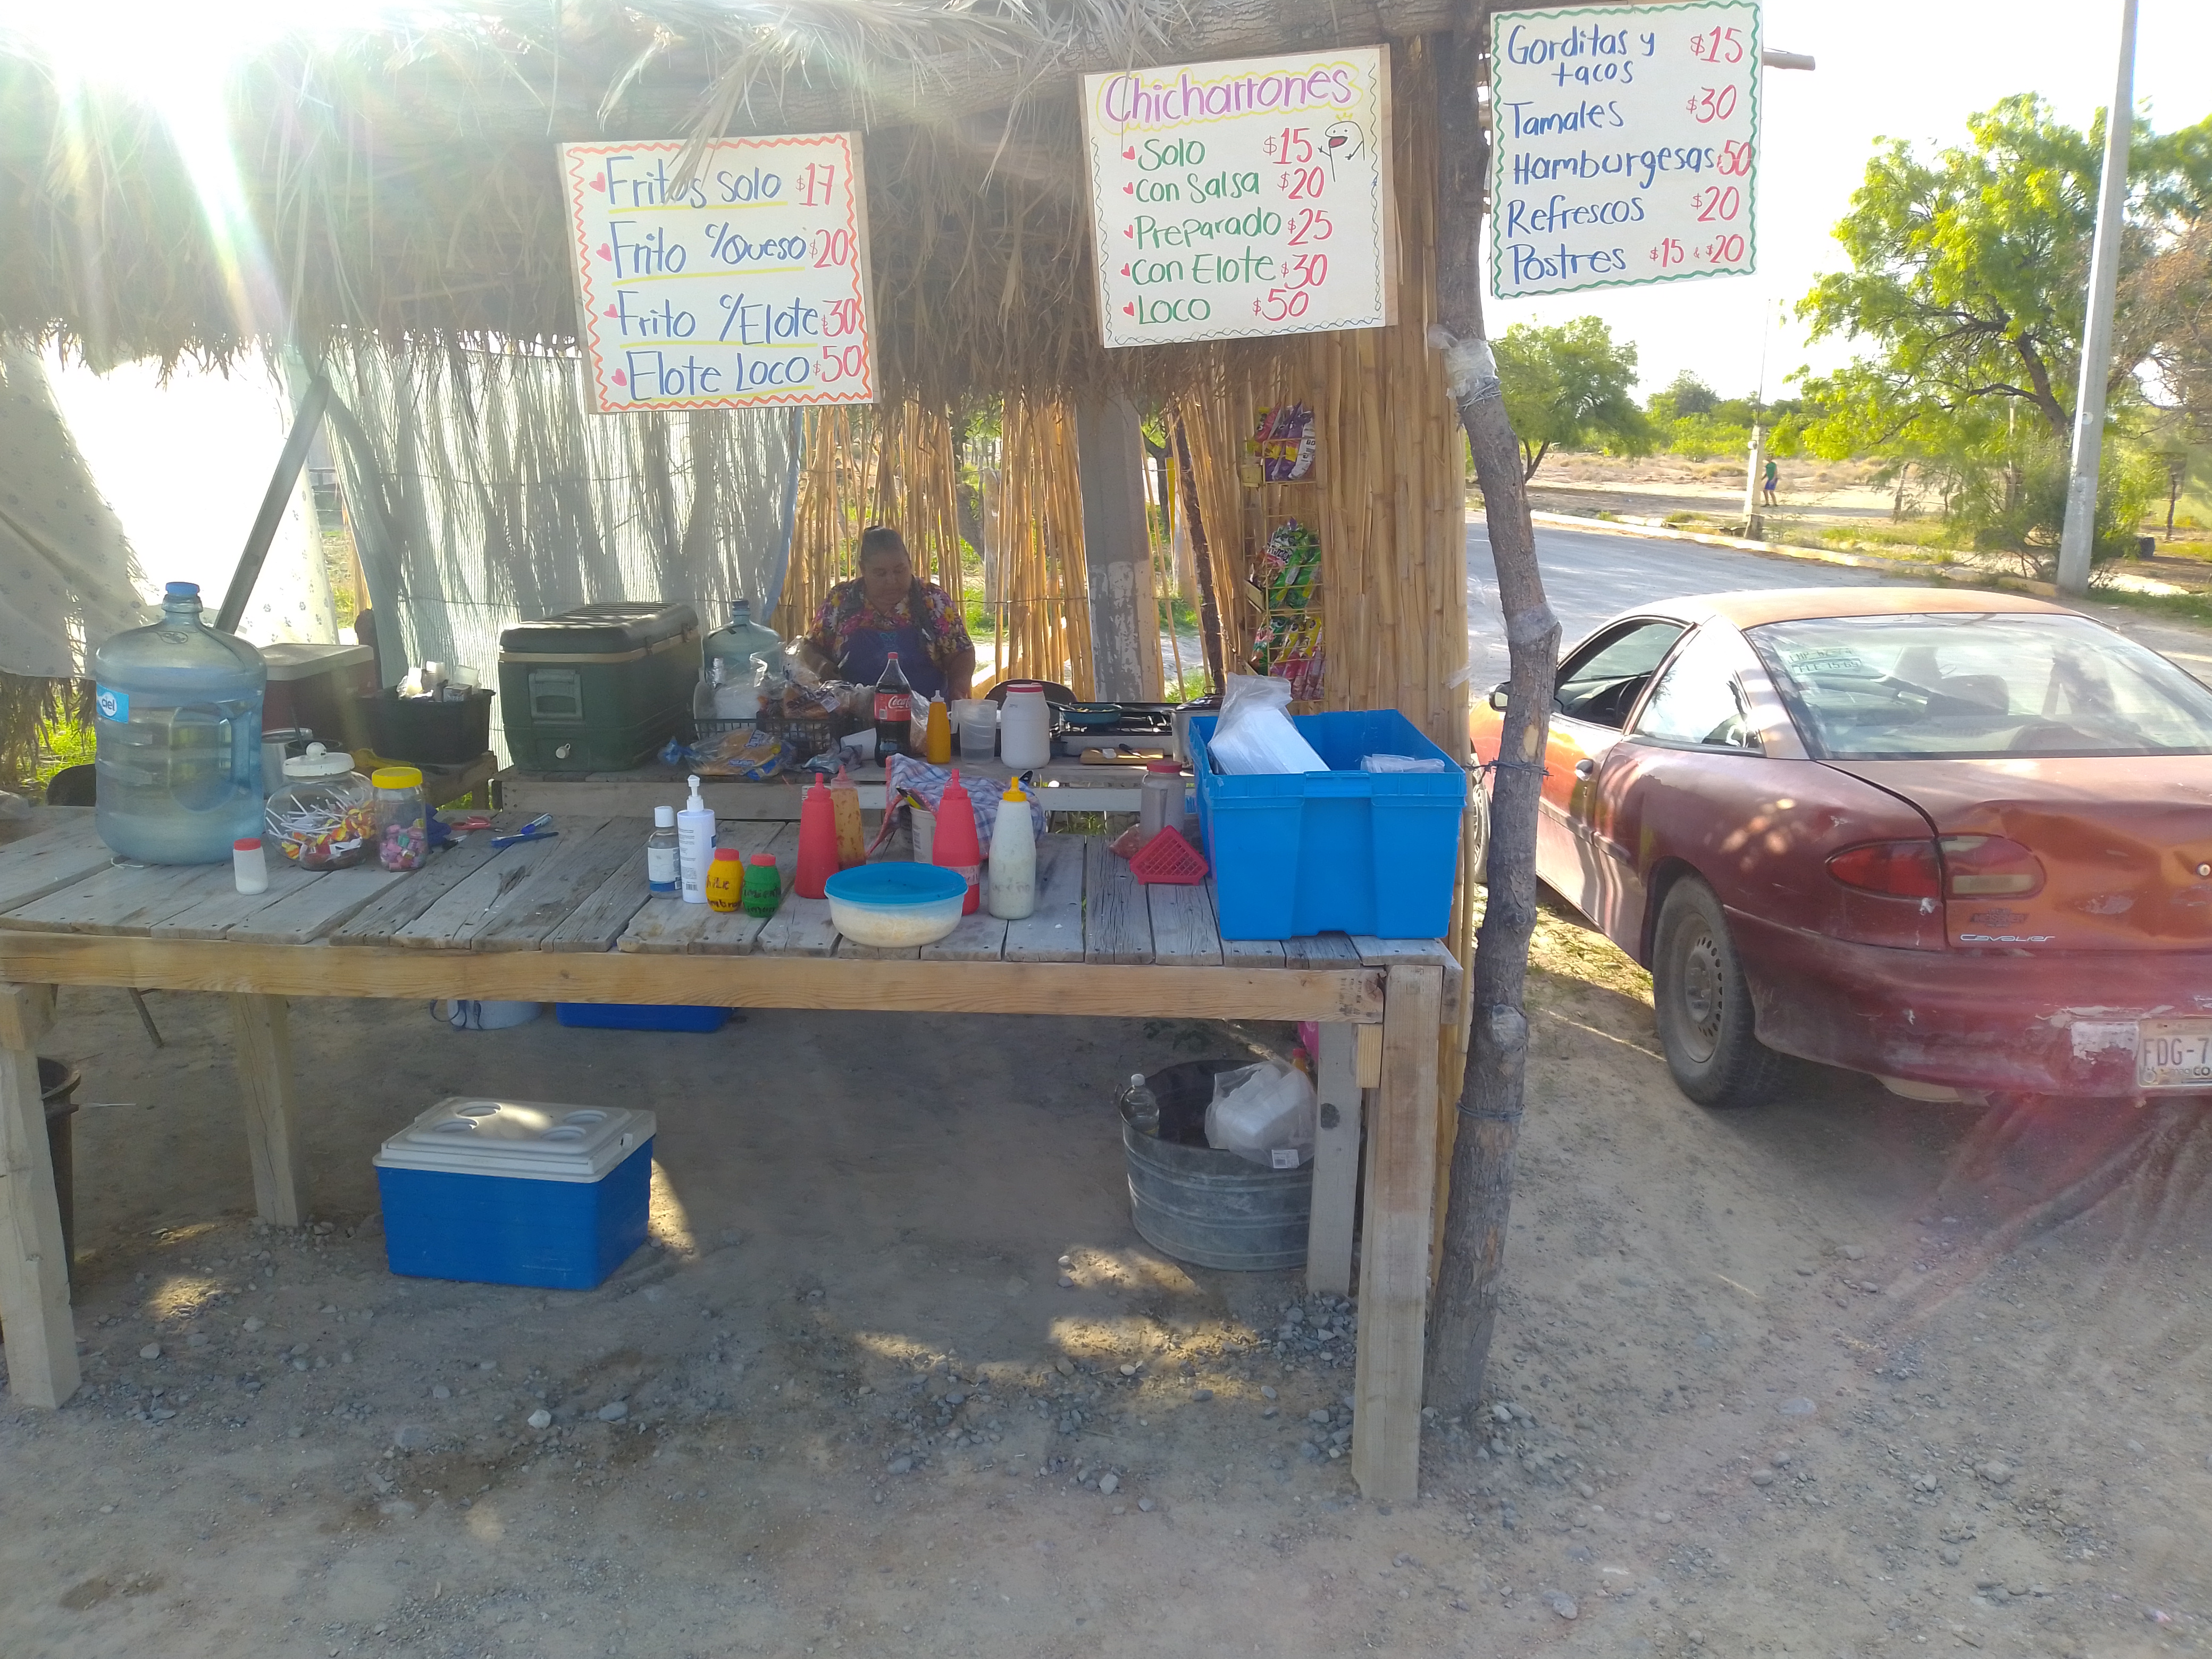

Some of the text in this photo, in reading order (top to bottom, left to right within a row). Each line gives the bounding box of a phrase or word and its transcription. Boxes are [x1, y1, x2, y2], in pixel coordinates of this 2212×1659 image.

[1508, 23, 1743, 64] Gorditas y $15
[1105, 69, 1352, 123] Chicharrones
[1552, 61, 1633, 87] tacos
[1503, 85, 1737, 138] Tamales $30
[1138, 127, 1313, 171] Solo $15
[1514, 139, 1753, 189] Hamburgesas $50
[606, 156, 707, 208] Fritos
[795, 162, 835, 207] $17
[1187, 171, 1260, 203] Salsa
[1277, 166, 1325, 199] $20
[1134, 206, 1333, 249] Preparado $25
[1507, 186, 1740, 238] Refrescos $20
[609, 221, 687, 279] Frito
[809, 229, 849, 269] $20
[1192, 246, 1276, 284] Elote
[1281, 254, 1327, 289] $30
[1506, 242, 1626, 284] Postres
[1649, 238, 1685, 267] $15
[1706, 234, 1745, 263] $20
[617, 290, 696, 338] Frito
[821, 298, 857, 337] $30
[1253, 288, 1309, 321] $50
[626, 345, 862, 401] Elote Loco $50
